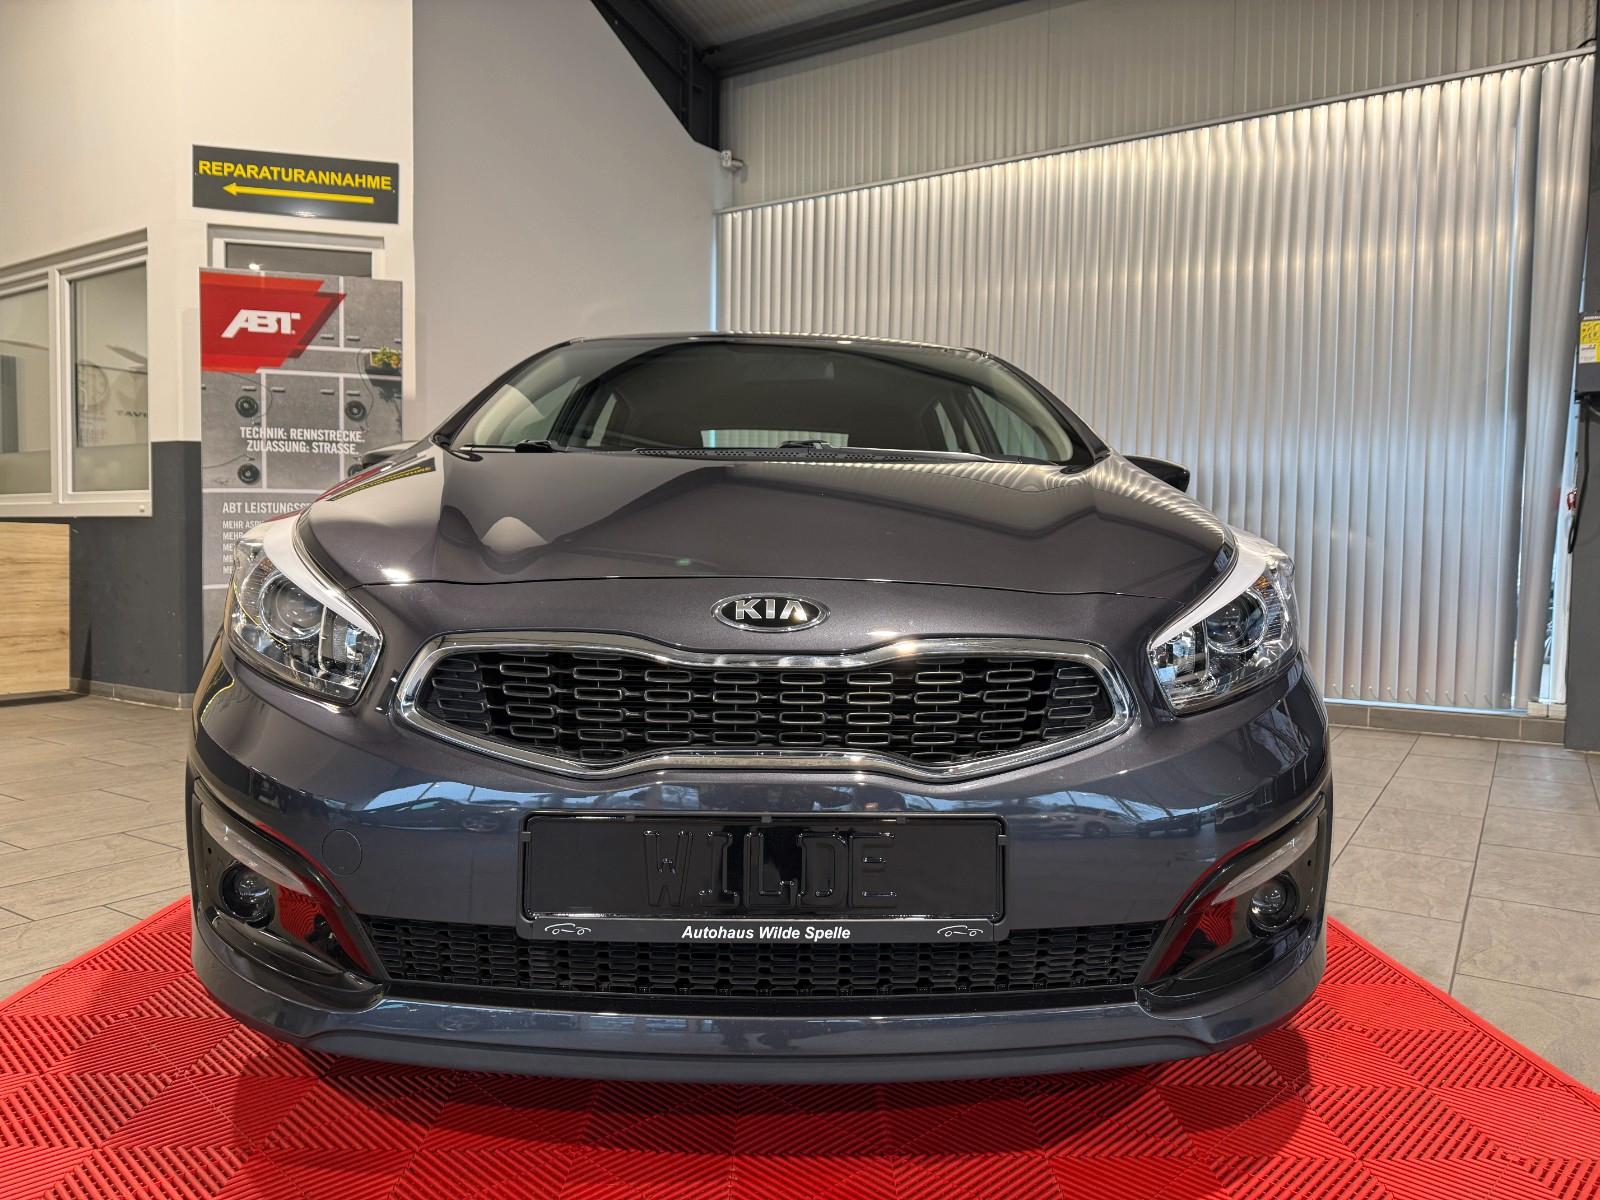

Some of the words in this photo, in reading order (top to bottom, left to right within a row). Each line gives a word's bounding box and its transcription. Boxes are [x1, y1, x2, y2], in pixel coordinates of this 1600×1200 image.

[198, 160, 392, 190] REPARATURANNAHME
[220, 309, 301, 338] ABT
[240, 426, 287, 440] TECHNIK:
[290, 428, 365, 443] RENNSTRECKE.
[246, 440, 309, 453] ZULASSUNG:
[312, 442, 359, 455] STRASSE.
[222, 502, 242, 514] ABT
[222, 520, 243, 529] MEHR
[735, 599, 808, 621] KIA
[643, 829, 897, 908] WILDE
[681, 926, 754, 939] Autohaus
[759, 926, 801, 939] Wilde
[804, 926, 851, 942] Spelle
